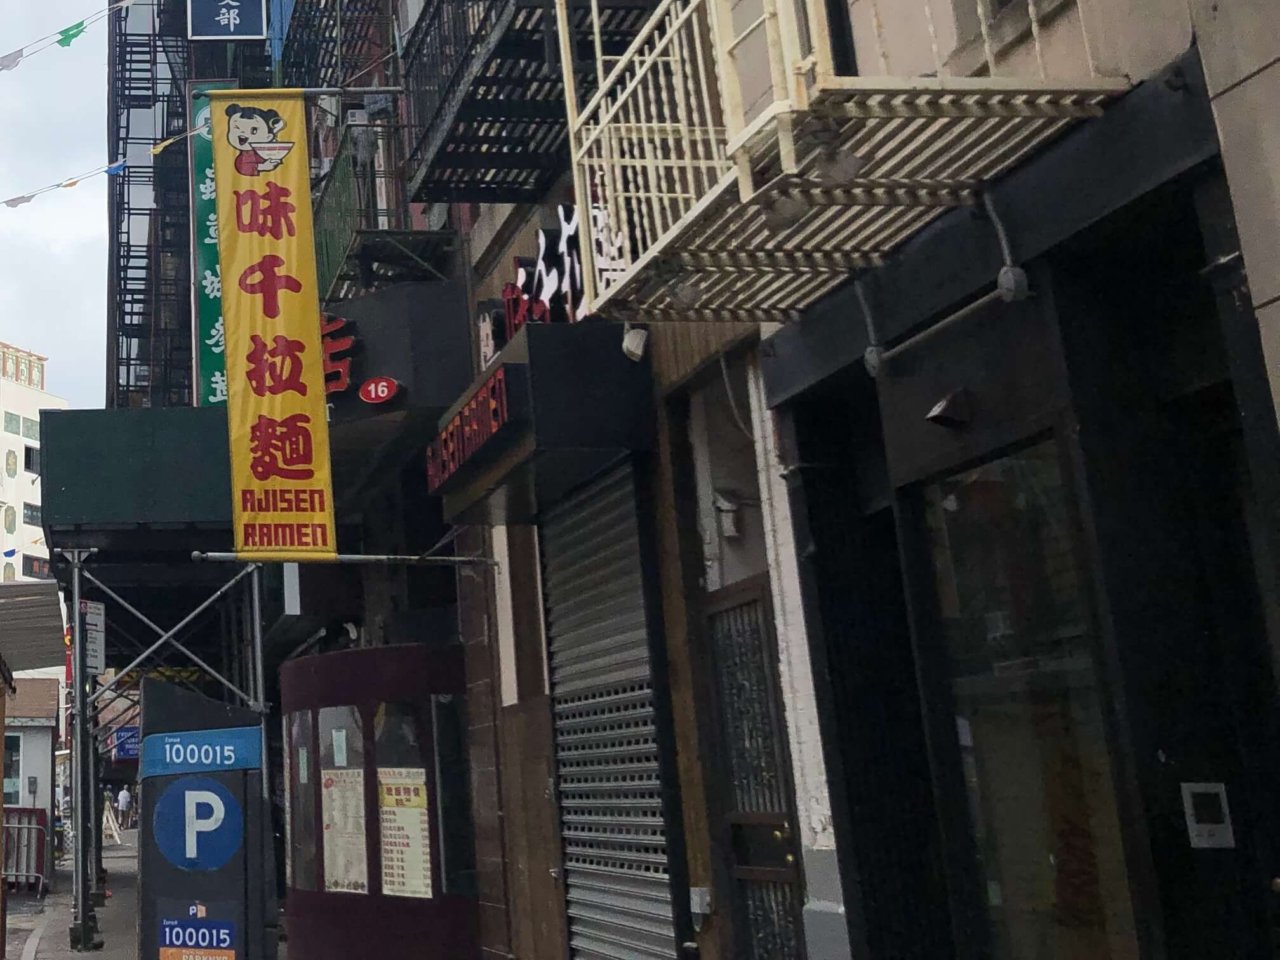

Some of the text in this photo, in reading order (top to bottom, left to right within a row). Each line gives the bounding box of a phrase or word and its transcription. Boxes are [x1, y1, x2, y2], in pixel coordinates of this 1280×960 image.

[234, 181, 315, 481] 味千拉麵
[367, 381, 389, 399] 16
[242, 489, 326, 515] AJISEN
[244, 523, 329, 548] RAMEN
[164, 744, 236, 765] 100015
[185, 790, 226, 859] P
[164, 927, 231, 948] 100015
